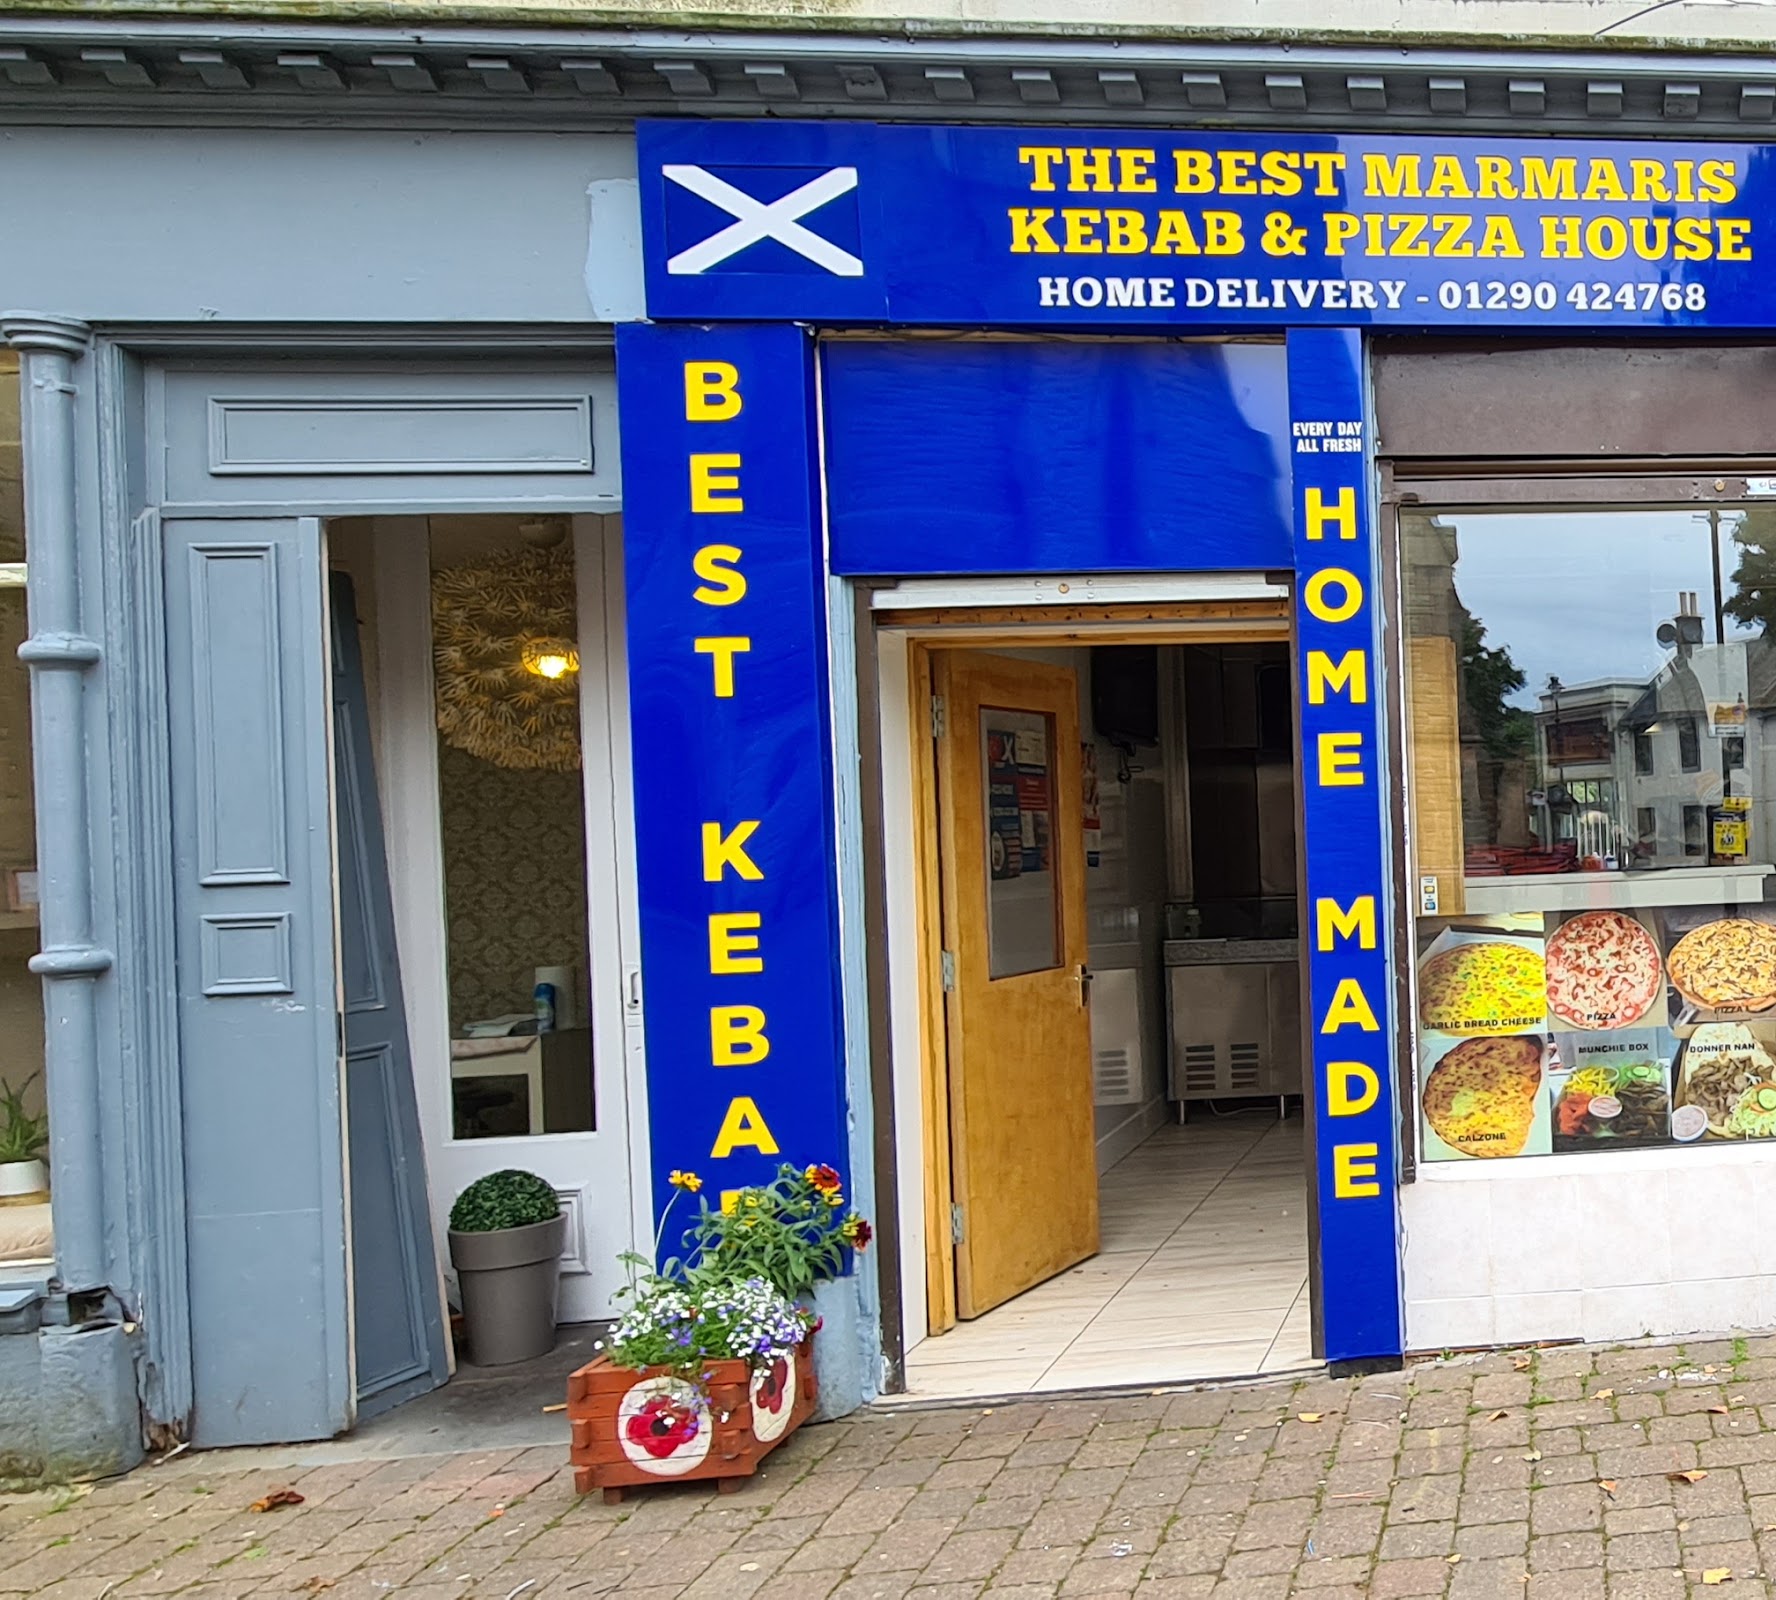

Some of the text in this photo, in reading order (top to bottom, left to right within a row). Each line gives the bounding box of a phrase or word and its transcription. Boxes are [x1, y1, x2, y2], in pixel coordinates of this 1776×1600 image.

[1018, 146, 1738, 204] THE BEST MARMARIS
[1008, 207, 1753, 261] KEBAB & PIZZA HOUSE
[1037, 276, 1176, 307] HOME
[1185, 277, 1408, 309] DELIVERY
[1437, 280, 1557, 310] 01290
[1566, 281, 1707, 312] 424768
[1293, 422, 1362, 436] EVERY DAY
[1296, 438, 1362, 452] ALL FRESH
[684, 360, 752, 699] BEST
[1305, 487, 1380, 1200] HOME MADE
[1423, 1017, 1542, 1030] GARLIC BREAD CHEESE
[1586, 1012, 1616, 1021] PIZZA
[1578, 1043, 1649, 1054] MUNCHIE BOX
[1734, 1043, 1755, 1051] NAN
[1458, 1132, 1506, 1142] CALZONE
